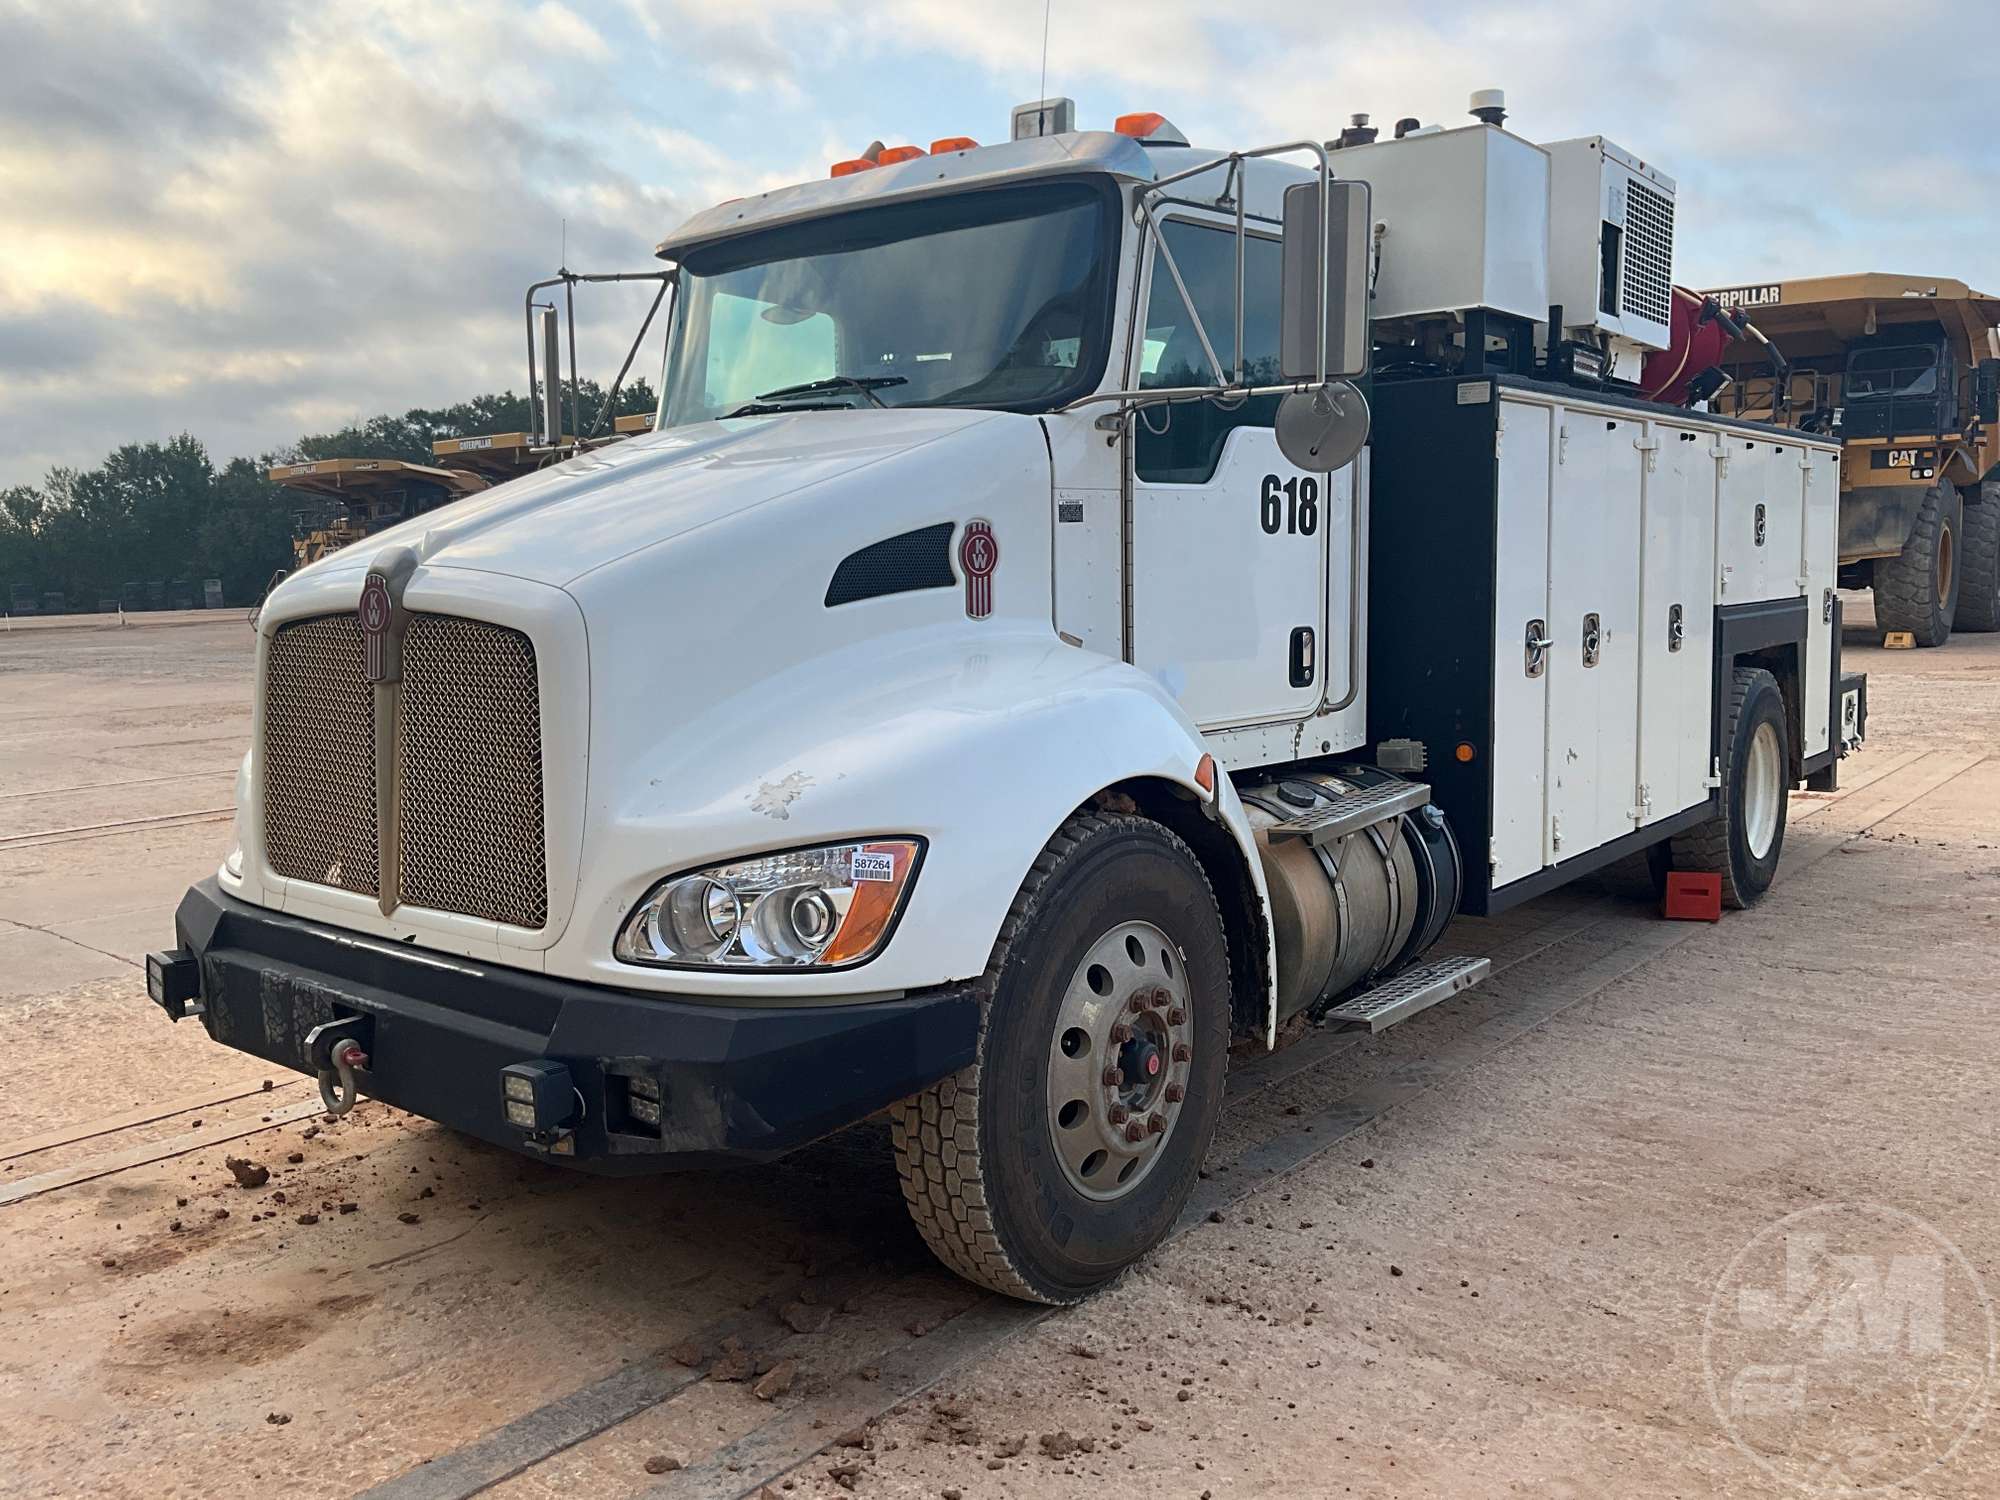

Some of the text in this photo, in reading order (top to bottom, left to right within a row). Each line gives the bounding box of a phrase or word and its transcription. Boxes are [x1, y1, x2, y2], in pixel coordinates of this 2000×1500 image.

[1705, 286, 1780, 307] ERPILLAR
[1888, 449, 1918, 467] CAT
[1260, 473, 1318, 536] 618
[854, 858, 890, 870] 587264
